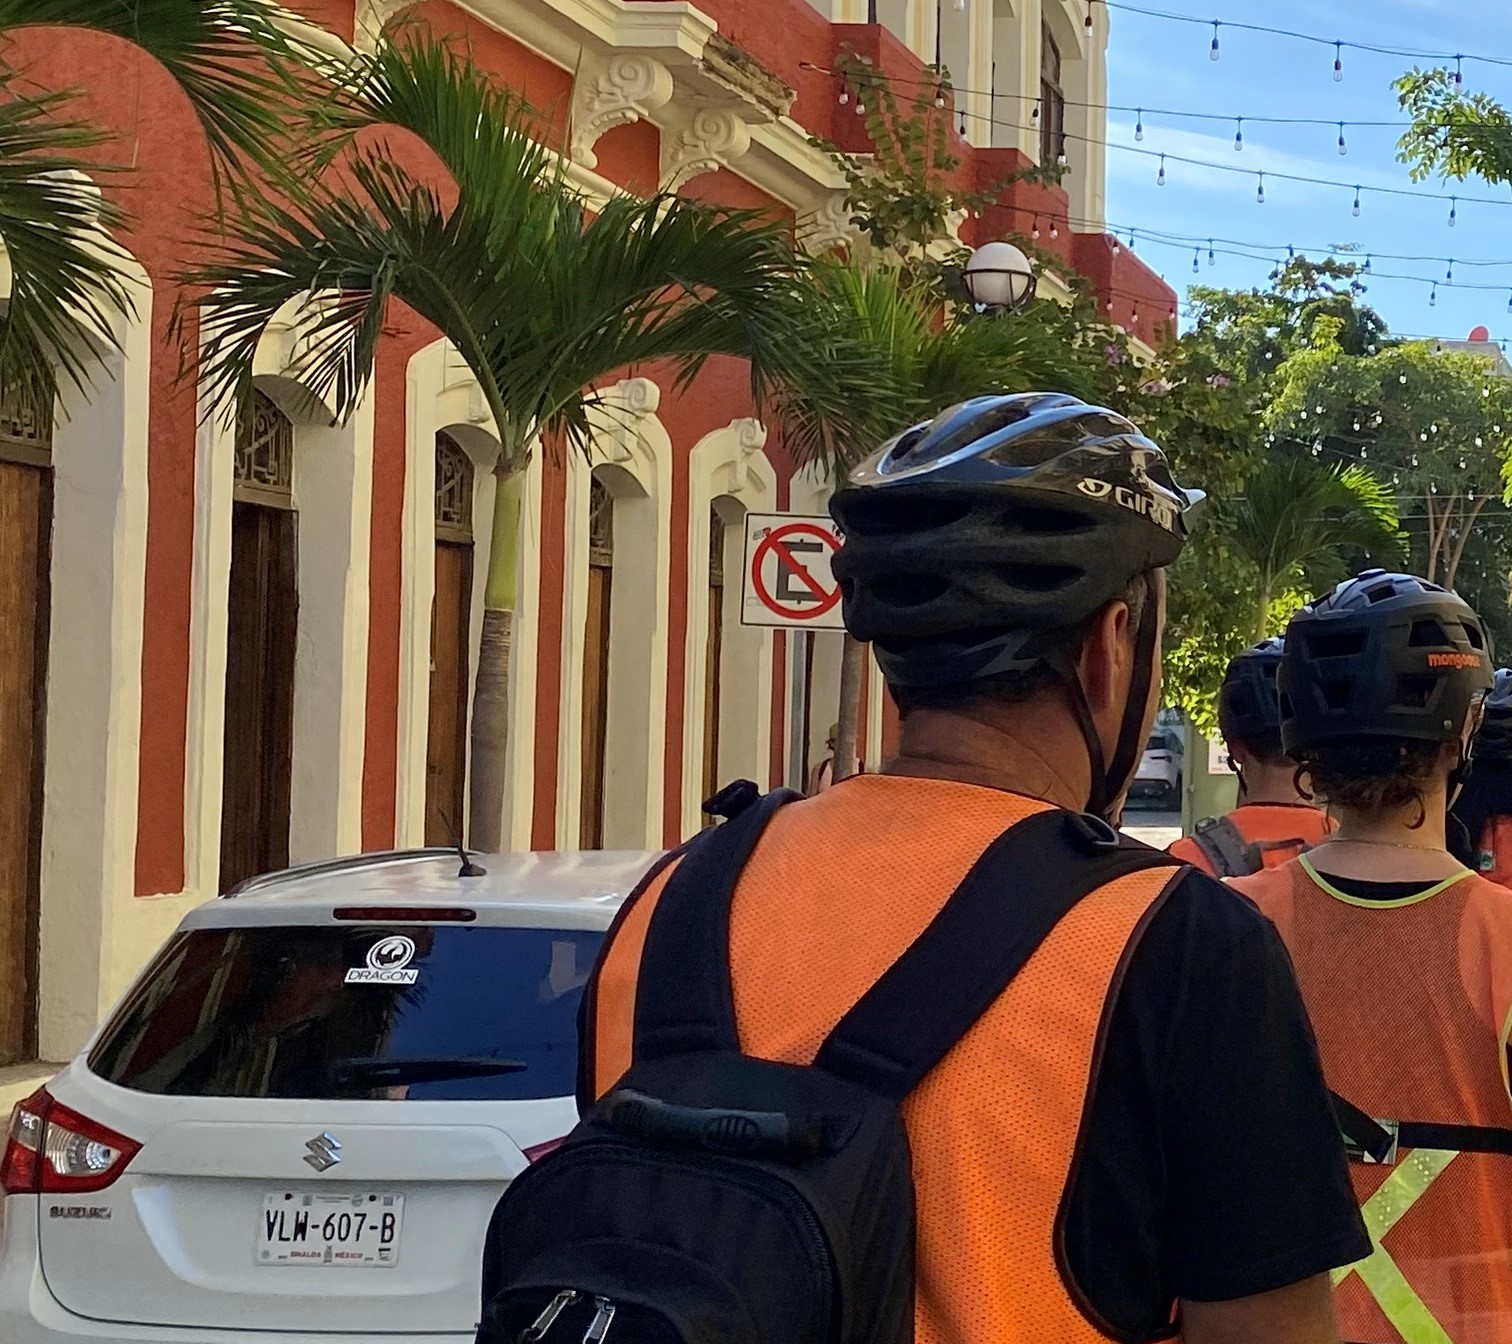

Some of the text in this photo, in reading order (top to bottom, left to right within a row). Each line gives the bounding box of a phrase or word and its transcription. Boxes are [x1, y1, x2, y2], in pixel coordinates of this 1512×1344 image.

[1115, 486, 1173, 533] GIRO
[347, 970, 415, 982] DRAGON
[266, 1209, 396, 1244] VLW-607-B
